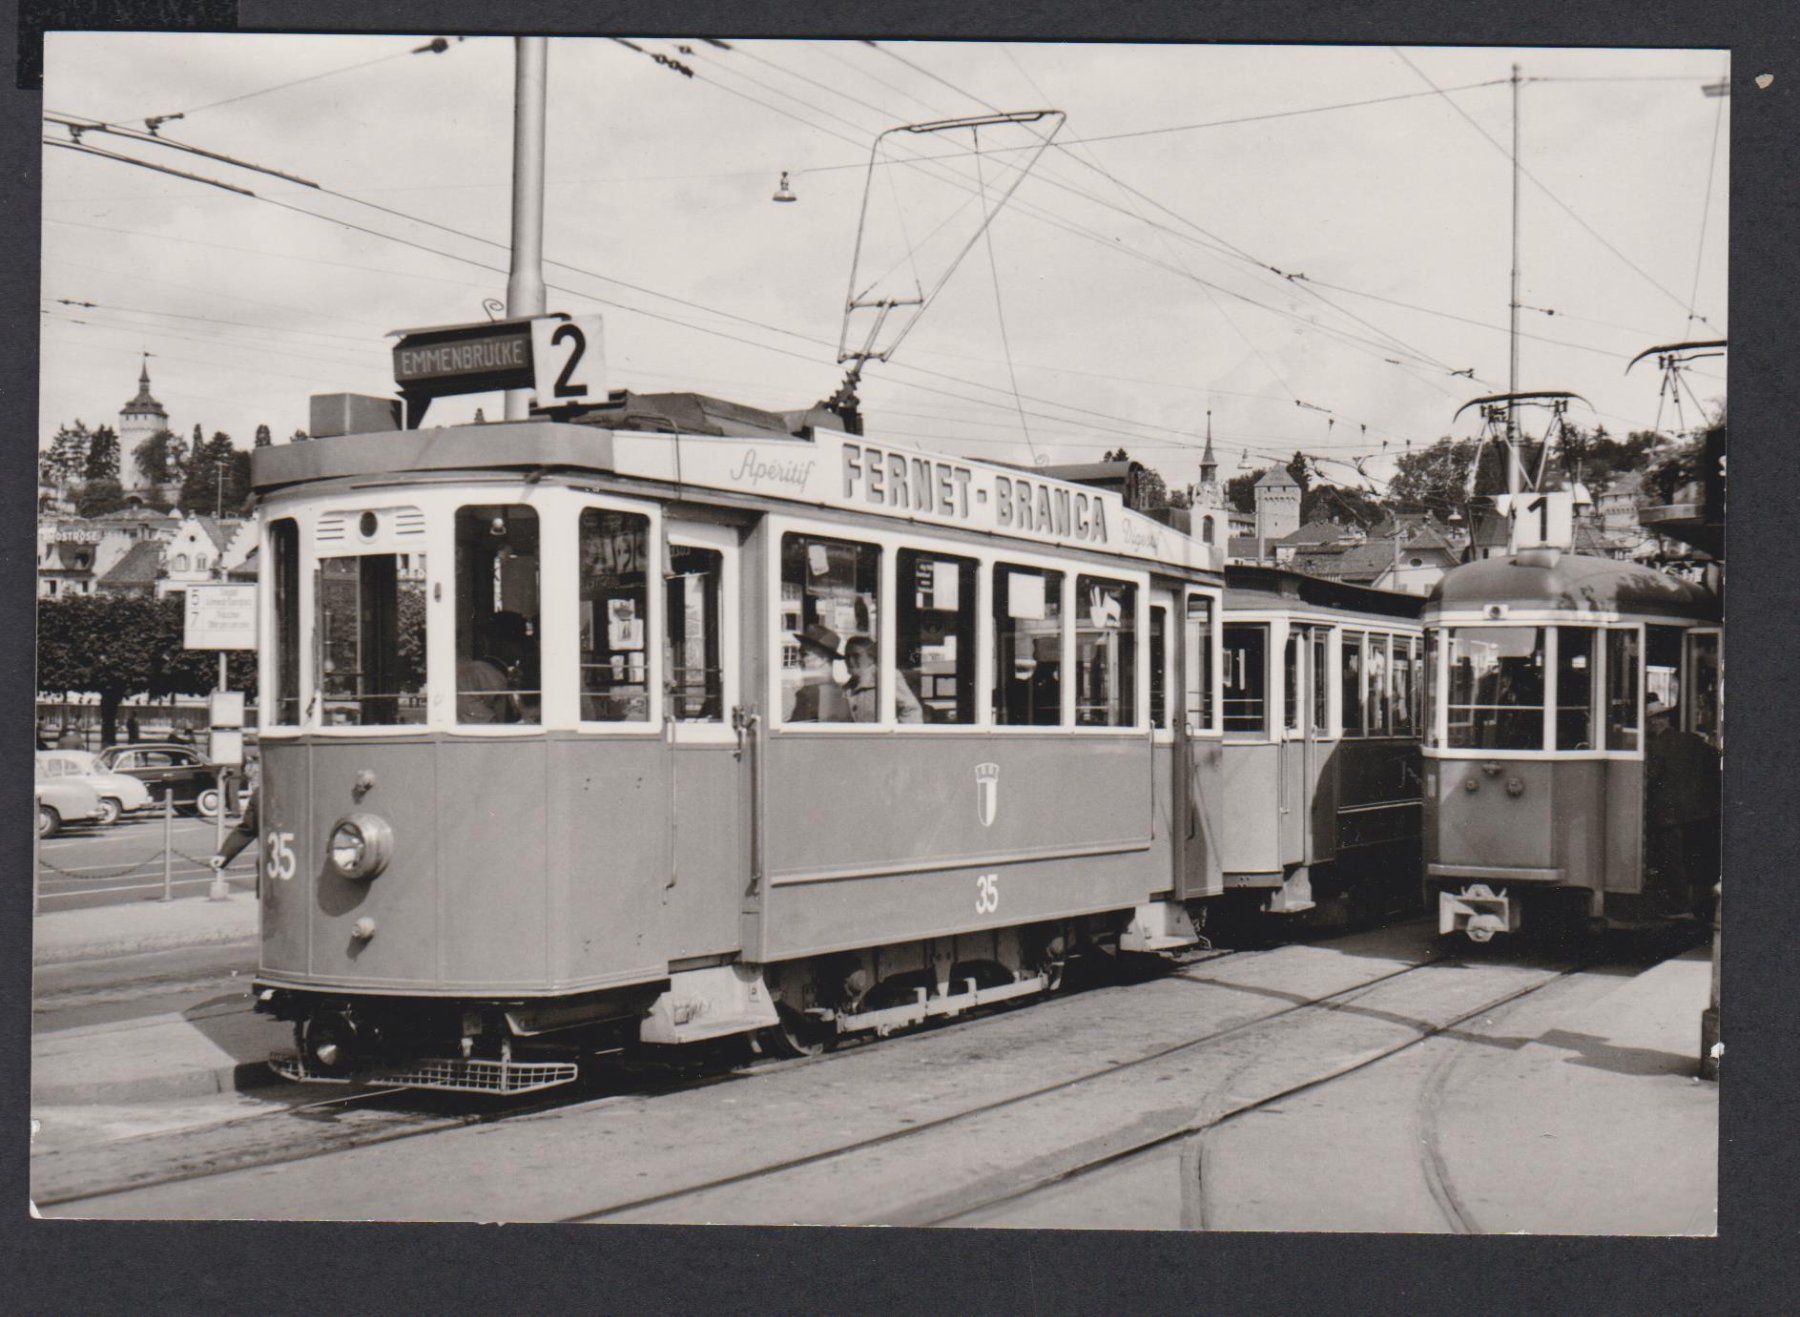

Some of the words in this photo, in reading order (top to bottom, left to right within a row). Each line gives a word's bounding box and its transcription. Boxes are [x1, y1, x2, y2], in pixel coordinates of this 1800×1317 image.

[402, 339, 523, 375] EMMENBRÜCKE
[551, 323, 588, 398] 2
[1527, 496, 1548, 541] 1
[191, 588, 200, 606] 5
[190, 611, 200, 629] 7
[267, 832, 296, 880] 35
[975, 873, 999, 914] 35
